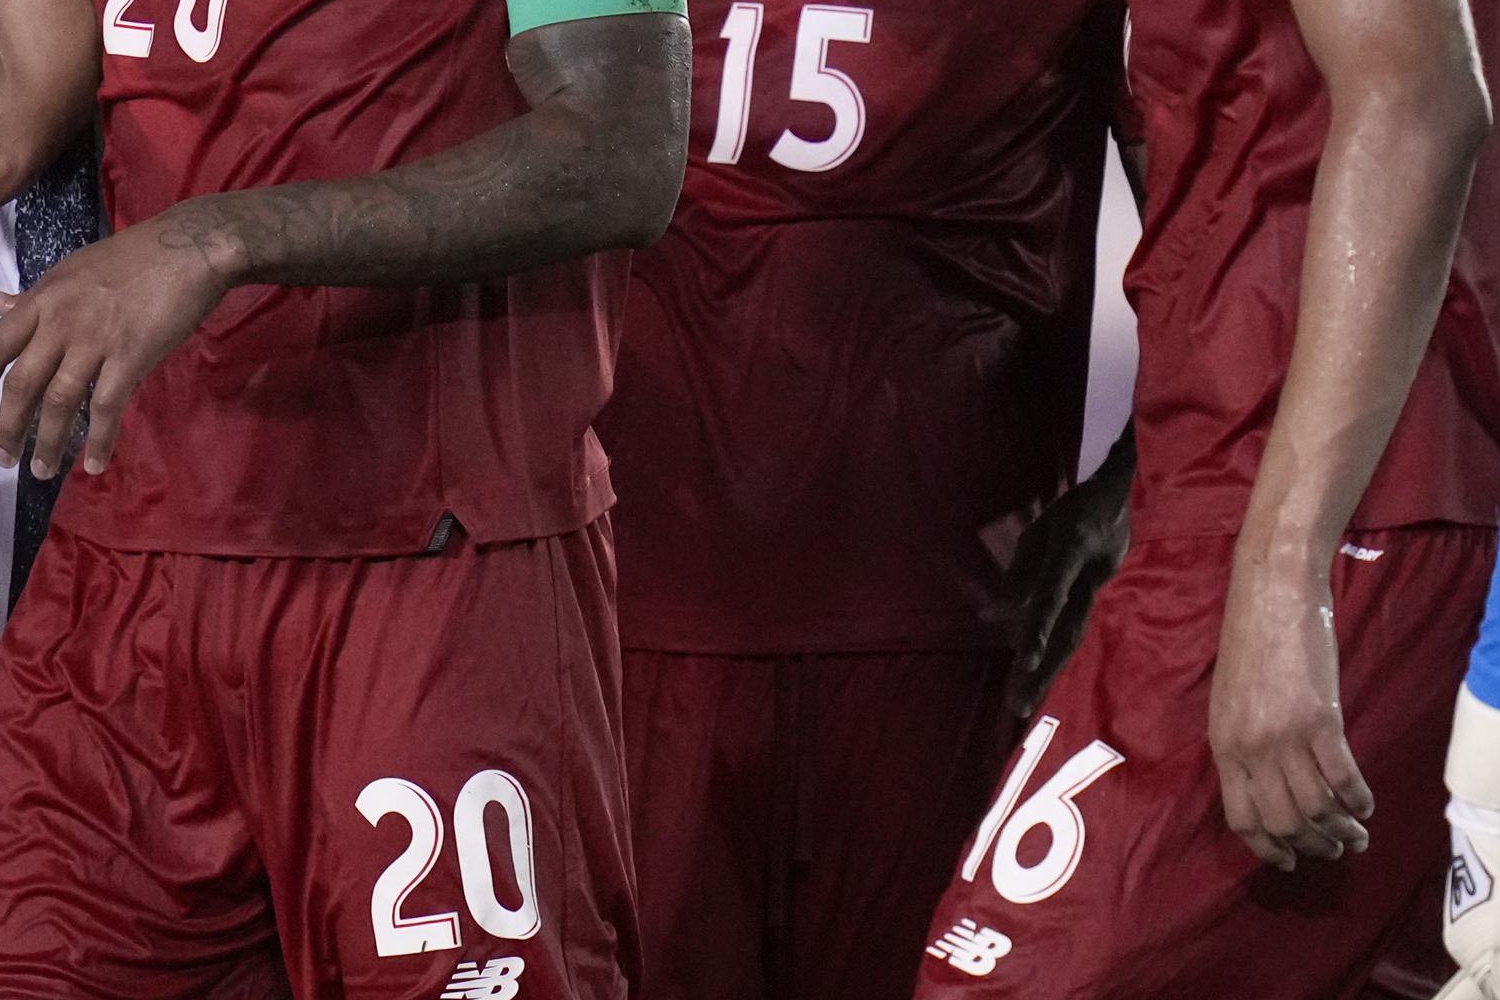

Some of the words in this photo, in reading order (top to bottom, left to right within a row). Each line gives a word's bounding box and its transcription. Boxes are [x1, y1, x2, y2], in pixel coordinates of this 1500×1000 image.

[706, 1, 875, 173] 15
[354, 768, 542, 958] 20
[960, 714, 1127, 905] 16
